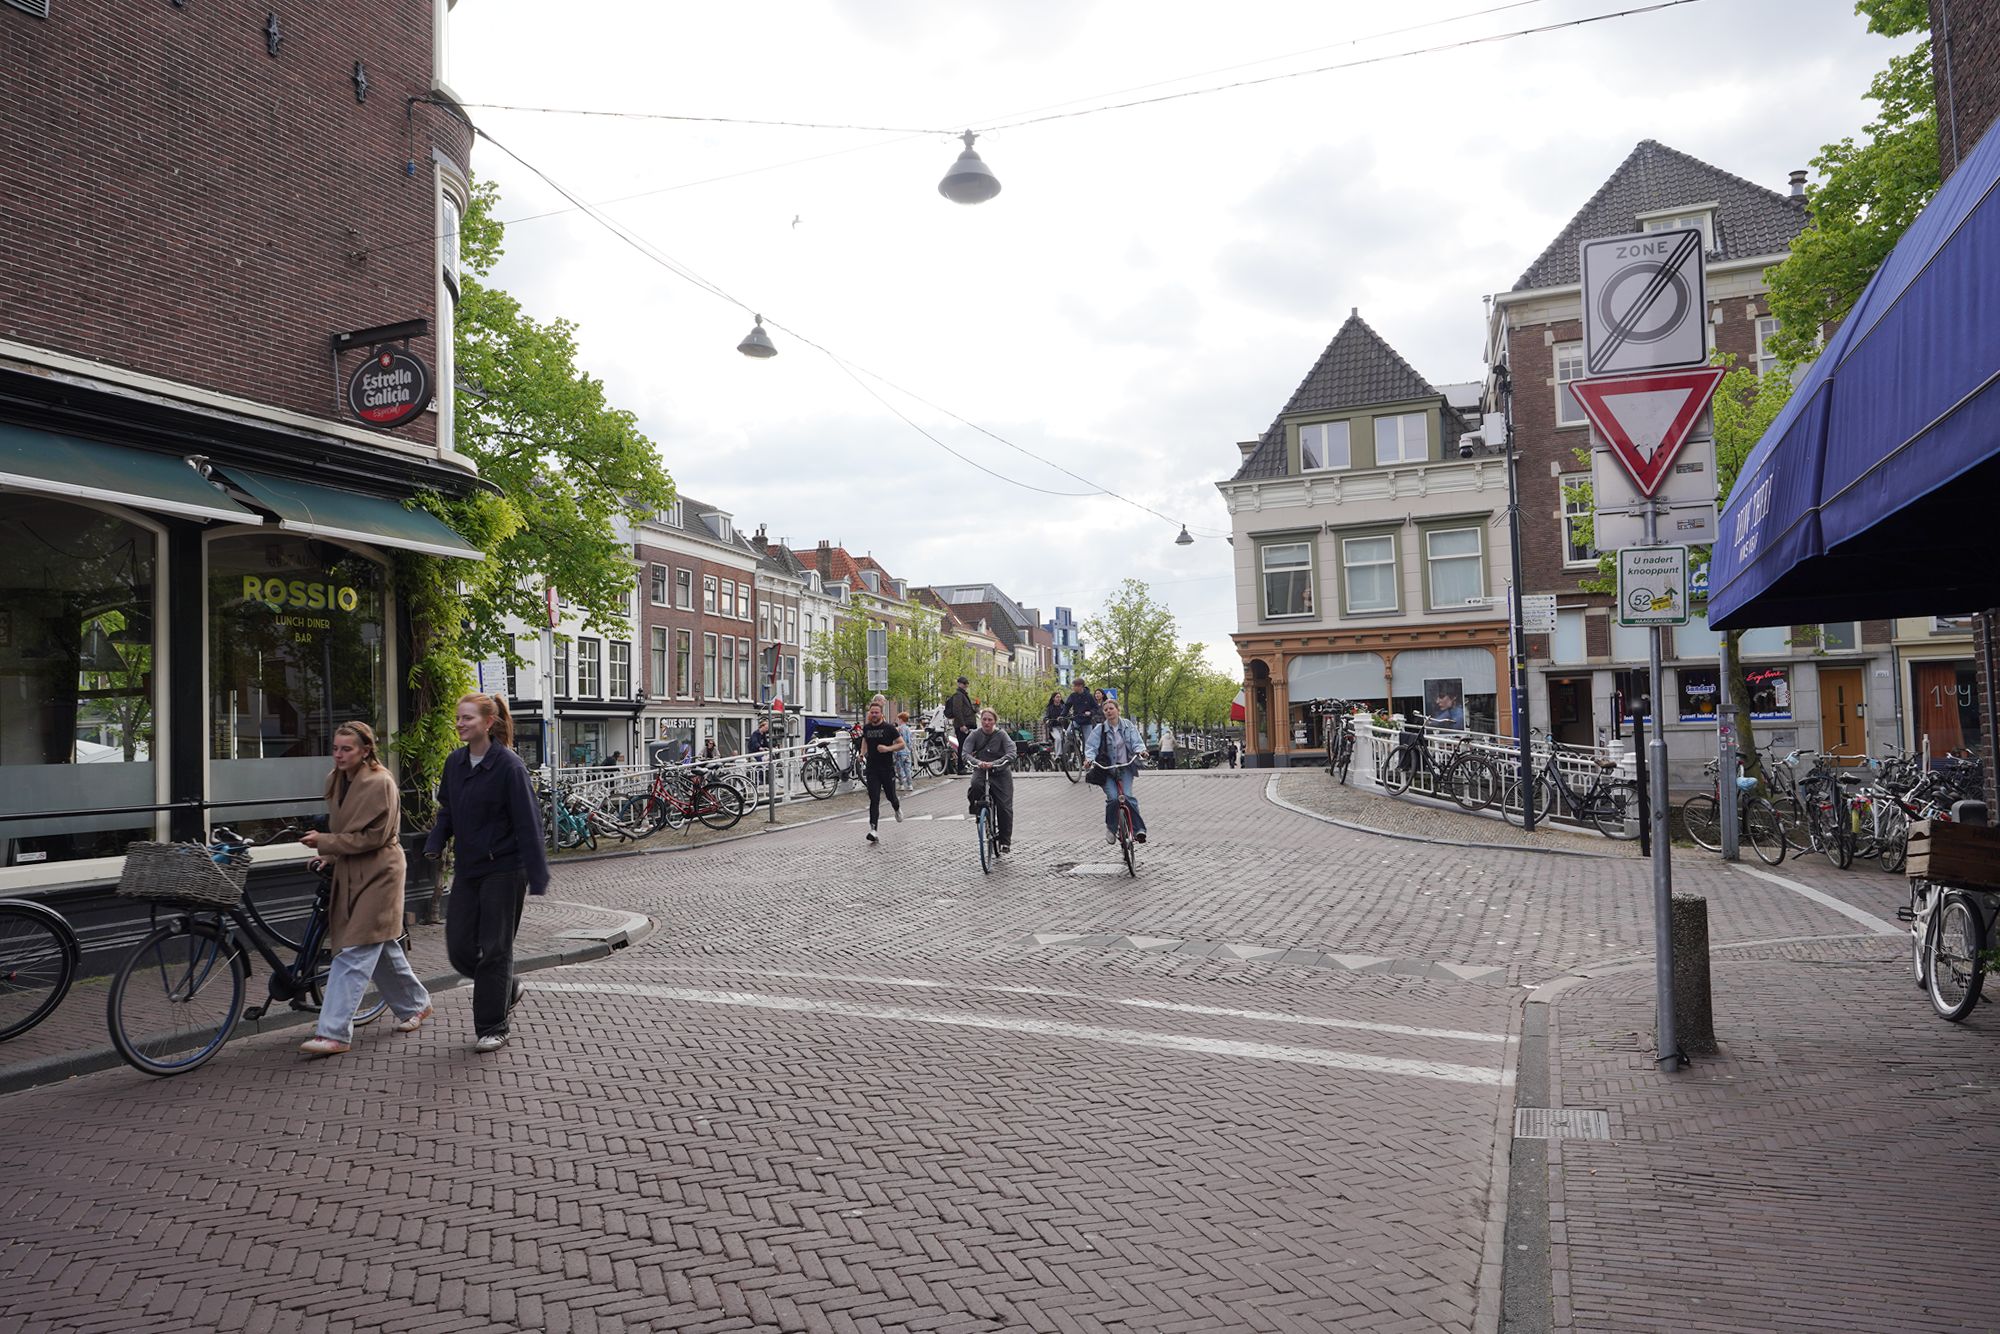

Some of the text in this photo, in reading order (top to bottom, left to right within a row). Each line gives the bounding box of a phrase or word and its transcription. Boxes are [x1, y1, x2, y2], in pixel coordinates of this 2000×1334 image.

[1616, 241, 1669, 259] ZONE
[362, 368, 412, 391] Estrella
[363, 385, 410, 407] Galicia
[1633, 556, 1674, 565] U nadert
[1628, 567, 1680, 577] knooppunt
[242, 575, 359, 613] ROSSIO
[1633, 594, 1651, 606] 52
[275, 615, 331, 630] LUNCH DINER
[295, 632, 312, 643] BAR
[678, 718, 696, 728] STYLE
